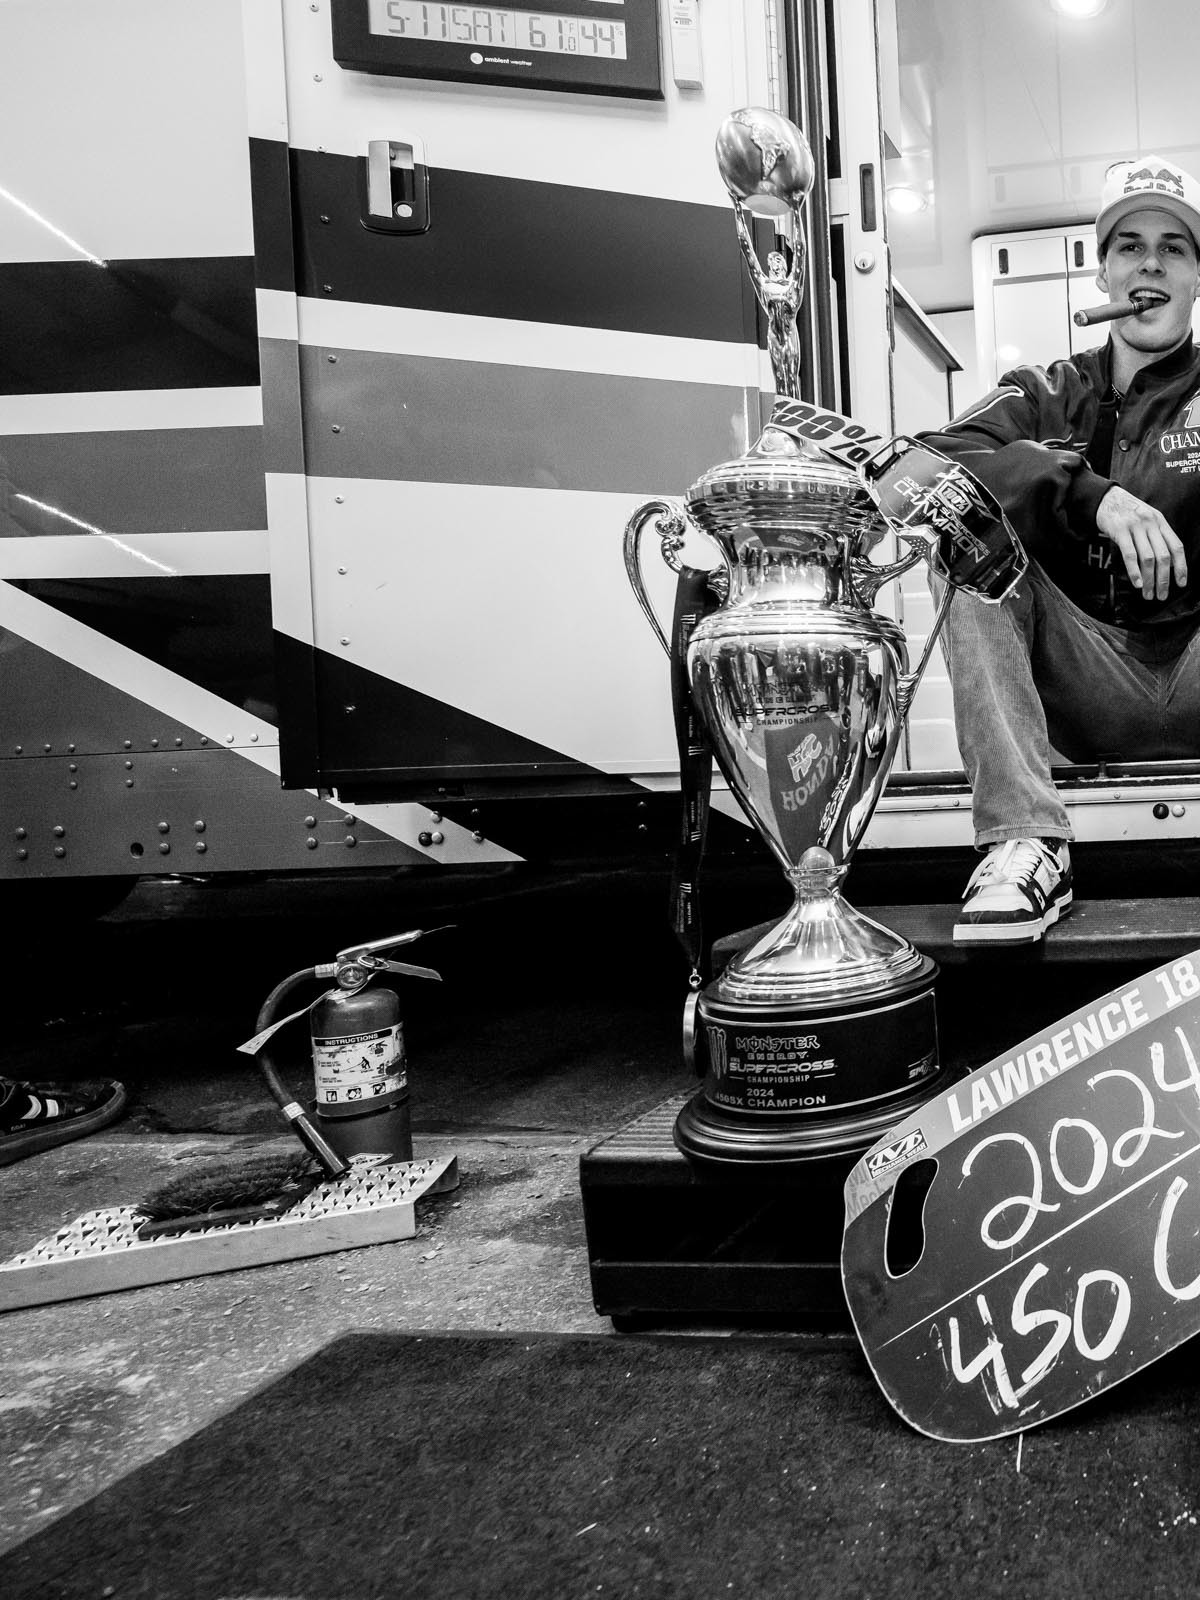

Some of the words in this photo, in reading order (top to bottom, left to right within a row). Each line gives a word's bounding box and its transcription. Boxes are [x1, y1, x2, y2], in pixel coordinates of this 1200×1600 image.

[452, 7, 508, 43] SAT
[893, 480, 986, 564] CHAMPION
[325, 1033, 379, 1046] INSTRUCTIONS
[735, 1035, 821, 1053] MONSTER
[947, 988, 1149, 1133] LAWRENCE
[1155, 960, 1200, 1009] 18
[729, 1059, 836, 1074] SUPERCROSS
[746, 1074, 811, 1084] CHAMPIONSHIP
[746, 1088, 774, 1097] 2024
[747, 1095, 827, 1108] CHAMPION
[949, 1262, 1132, 1412] 450
